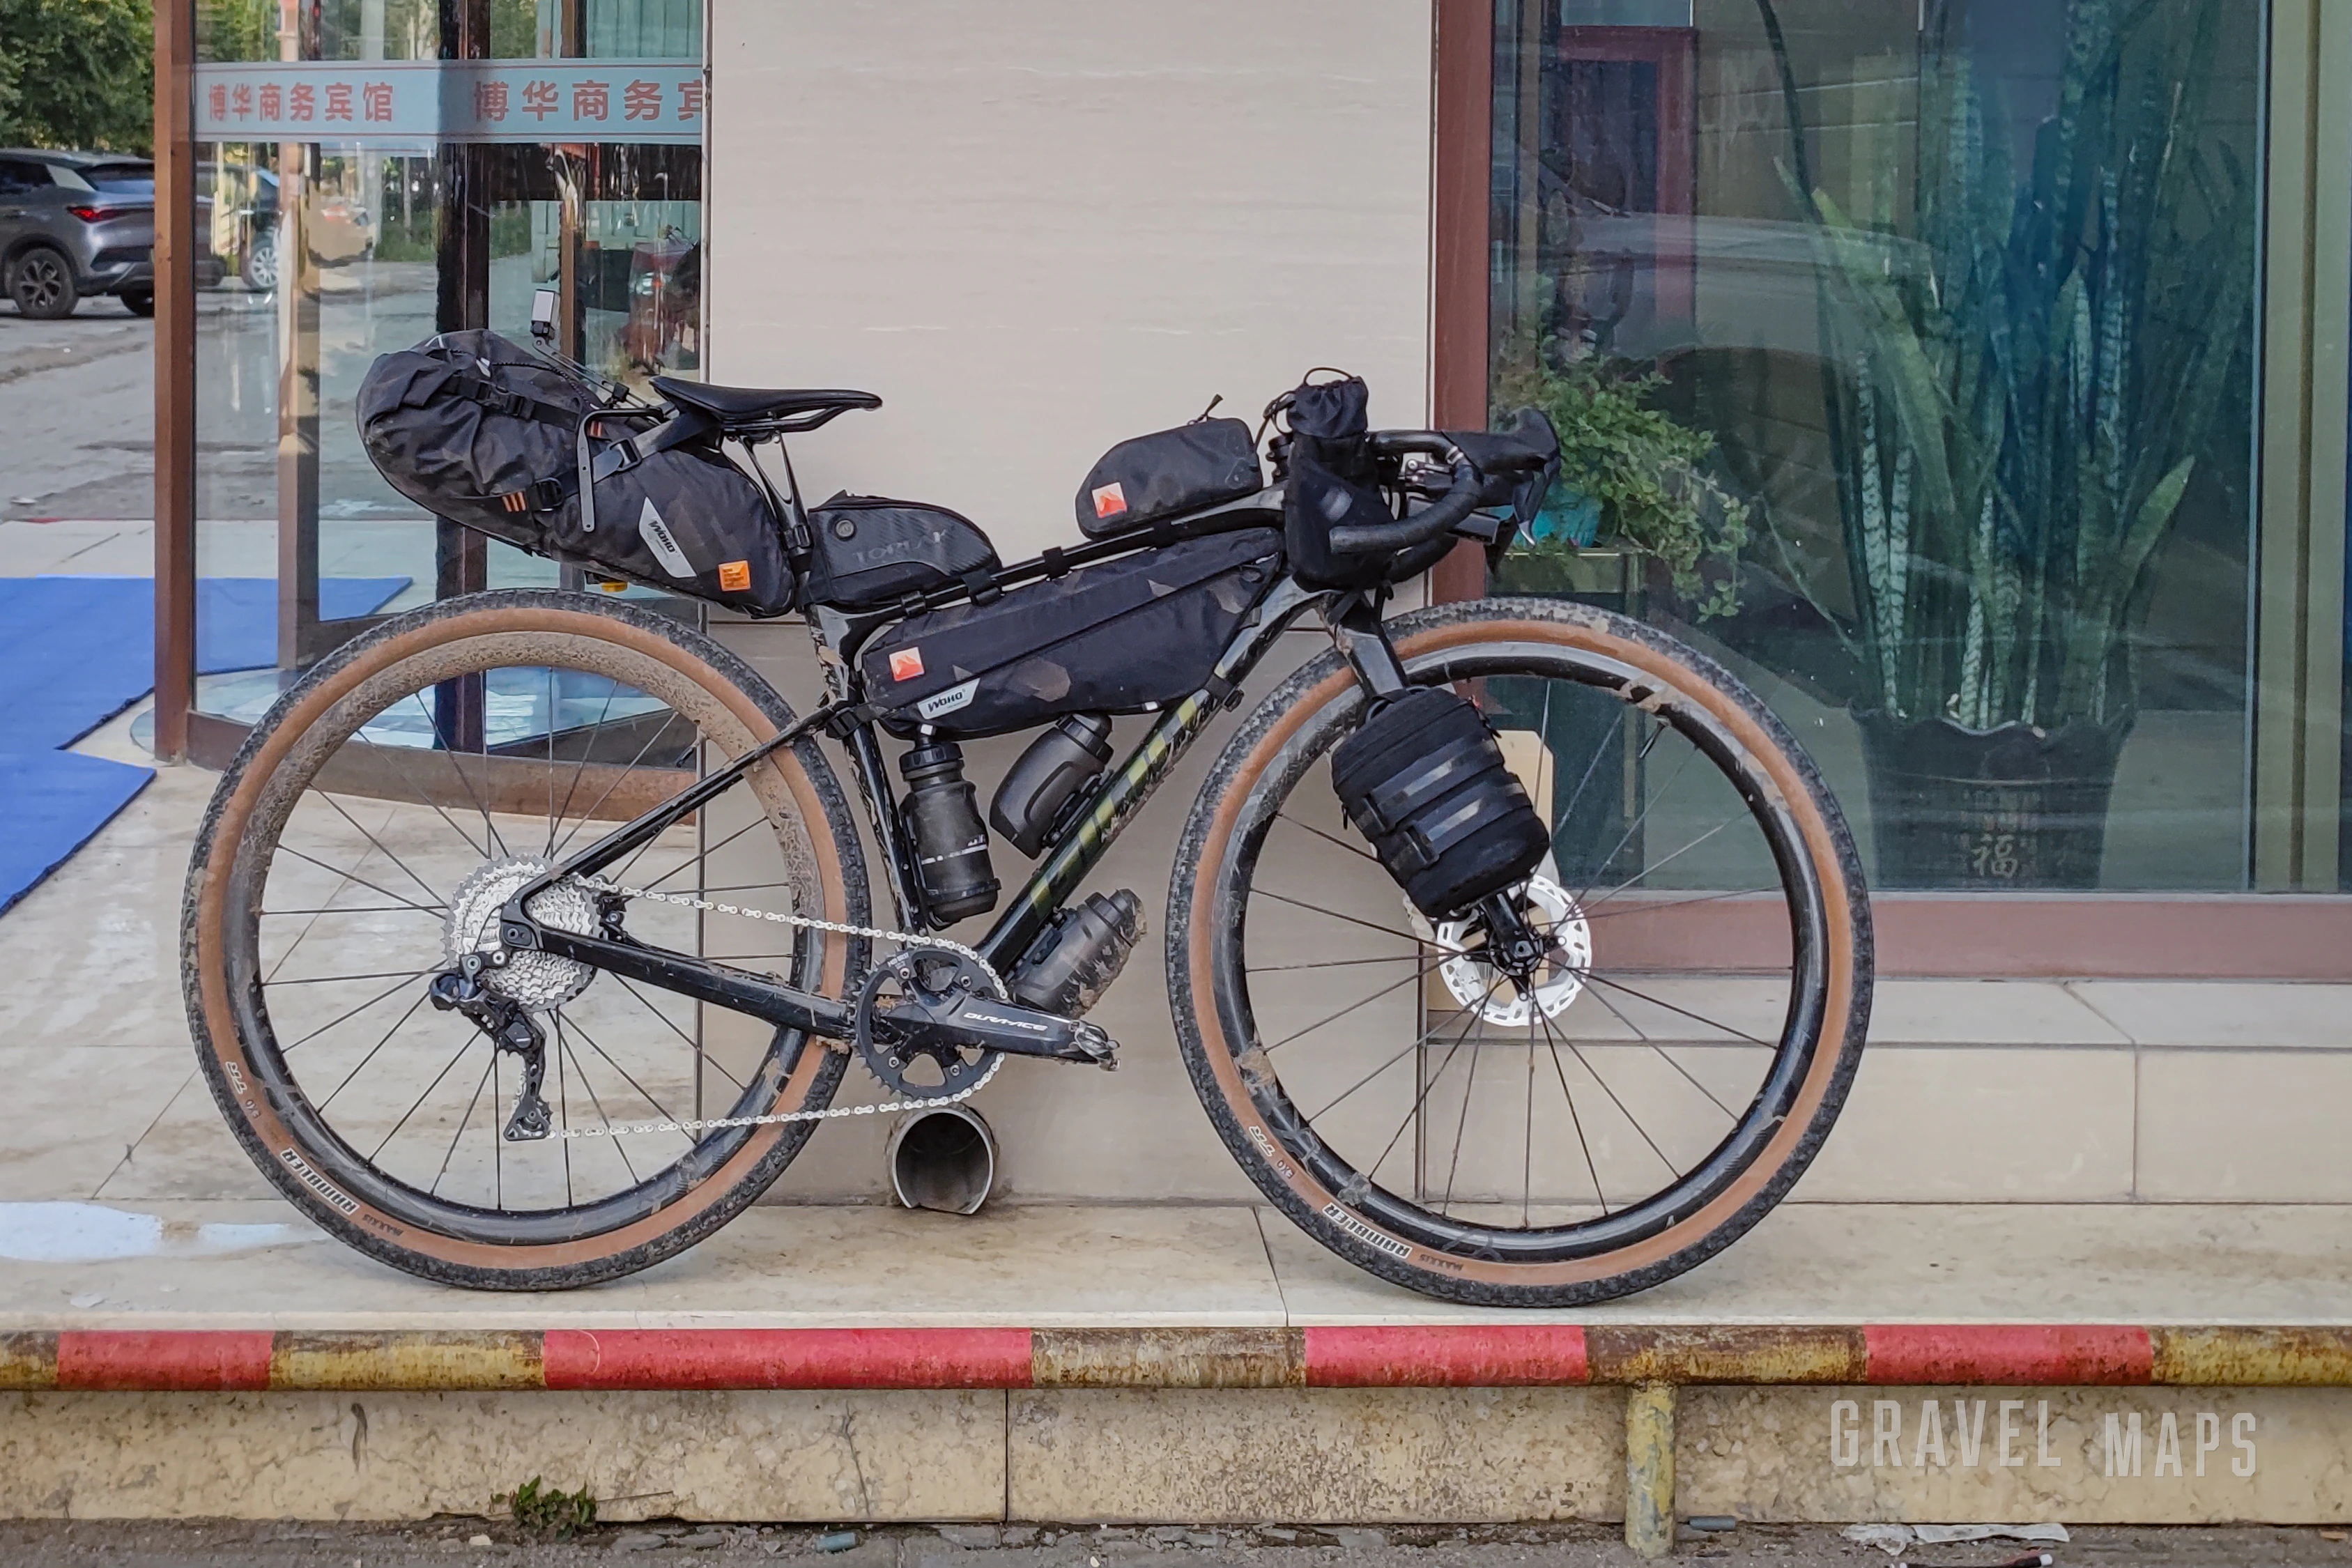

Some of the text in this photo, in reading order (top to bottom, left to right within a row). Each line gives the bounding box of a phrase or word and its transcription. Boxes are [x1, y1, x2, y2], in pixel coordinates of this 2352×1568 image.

[209, 81, 394, 123] 博华商务宾馆
[1971, 833, 2019, 879] 福
[963, 1011, 1049, 1032] DURA-ACE
[280, 1146, 361, 1216] RAMBLER
[1322, 1202, 1413, 1259] RAMBLER
